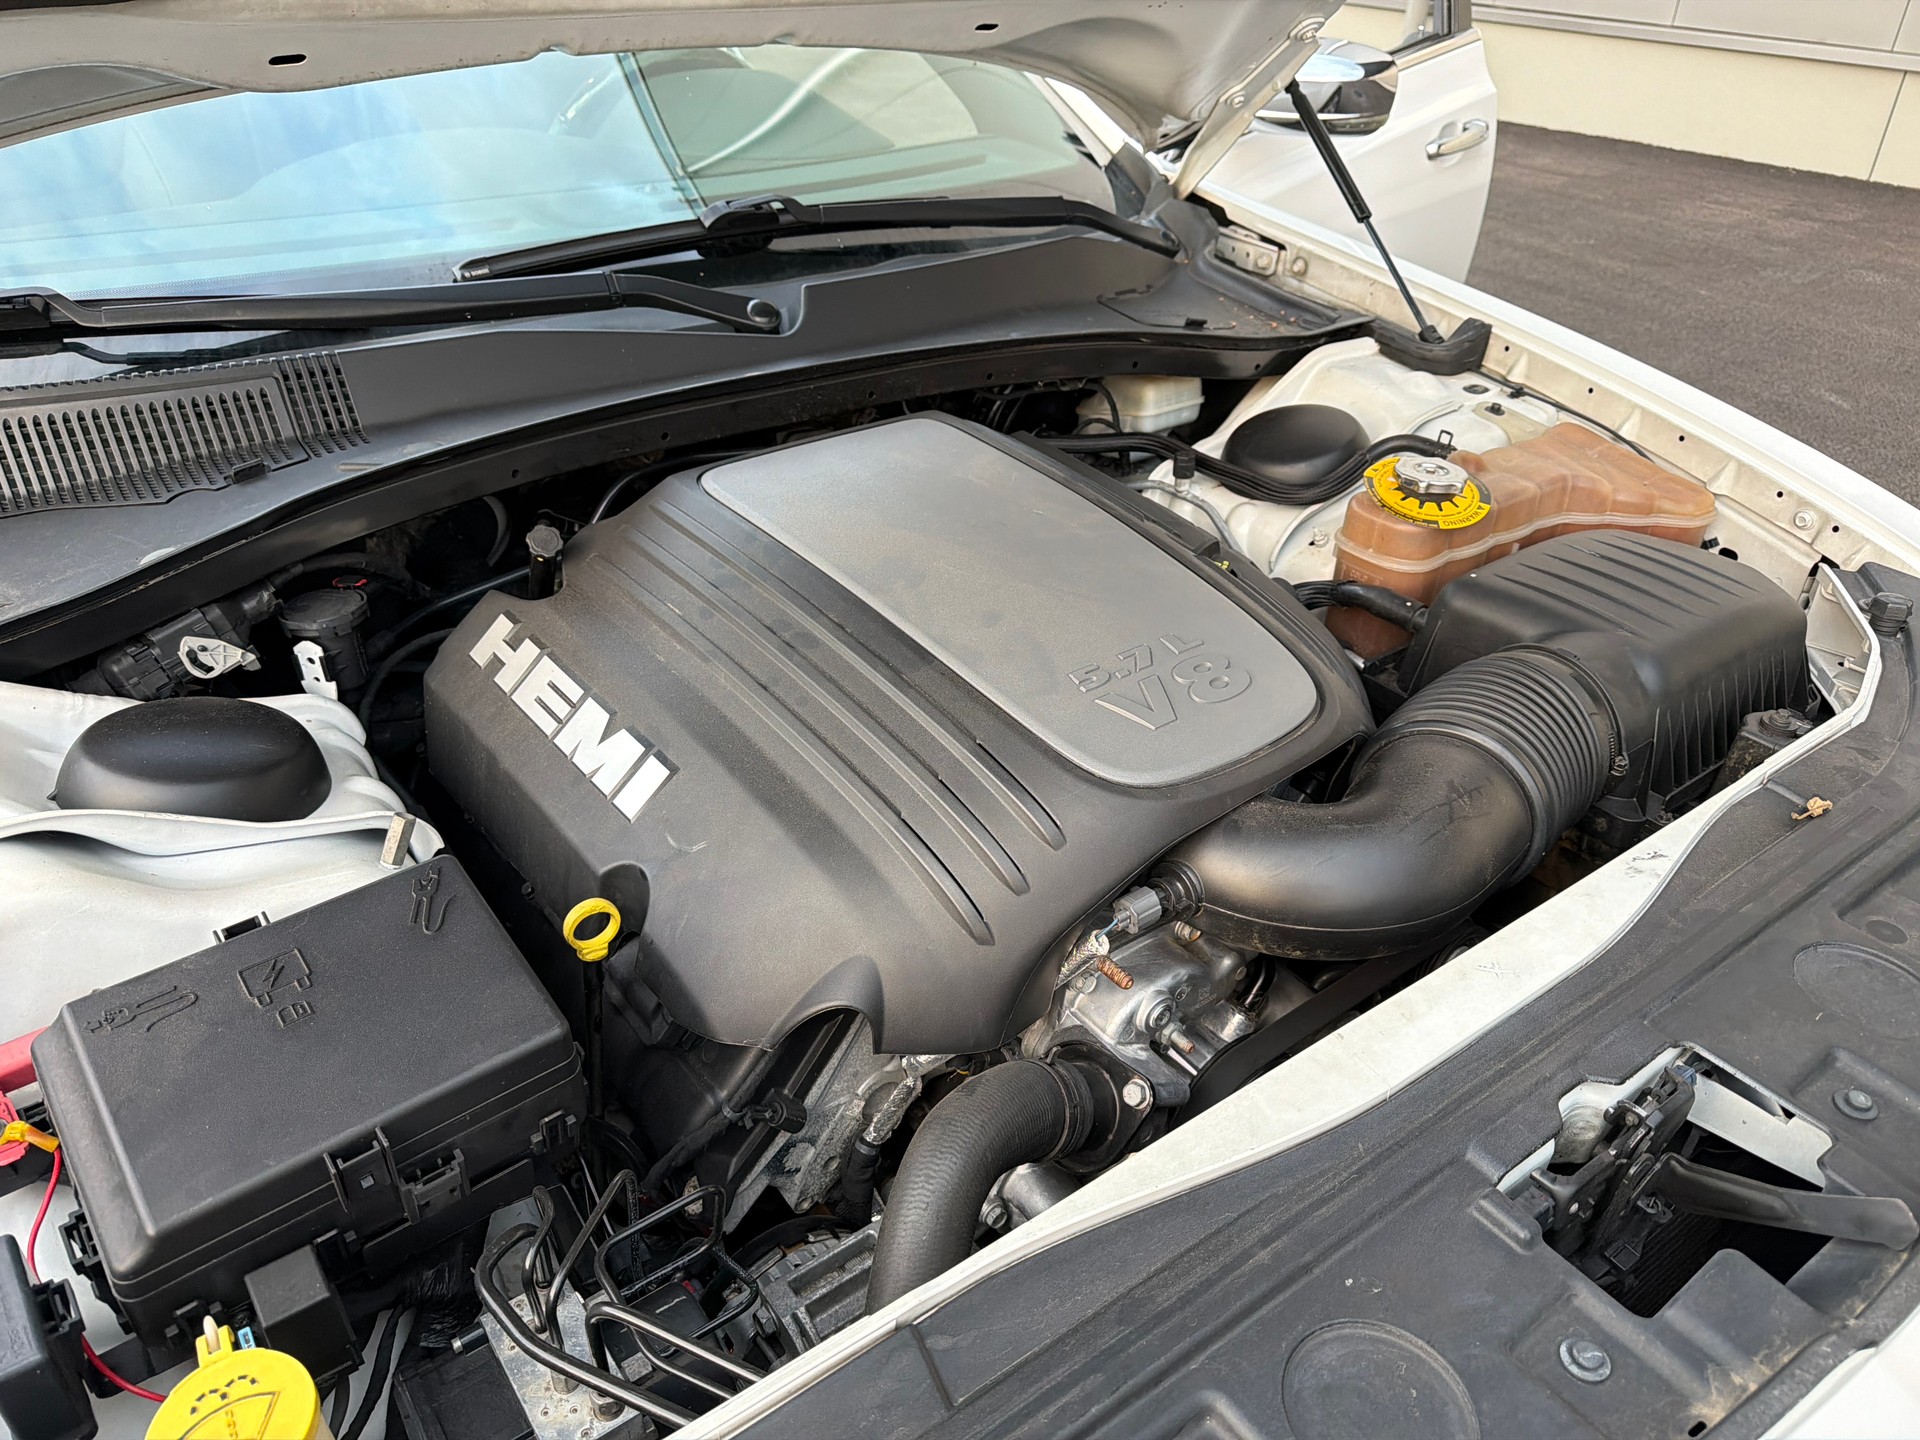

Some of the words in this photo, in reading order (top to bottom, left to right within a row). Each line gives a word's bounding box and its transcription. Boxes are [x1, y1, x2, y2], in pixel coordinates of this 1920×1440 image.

[1442, 510, 1483, 527] WARNING
[1067, 643, 1154, 693] 5.7
[1094, 653, 1253, 731] V8
[468, 612, 674, 824] HEMI
